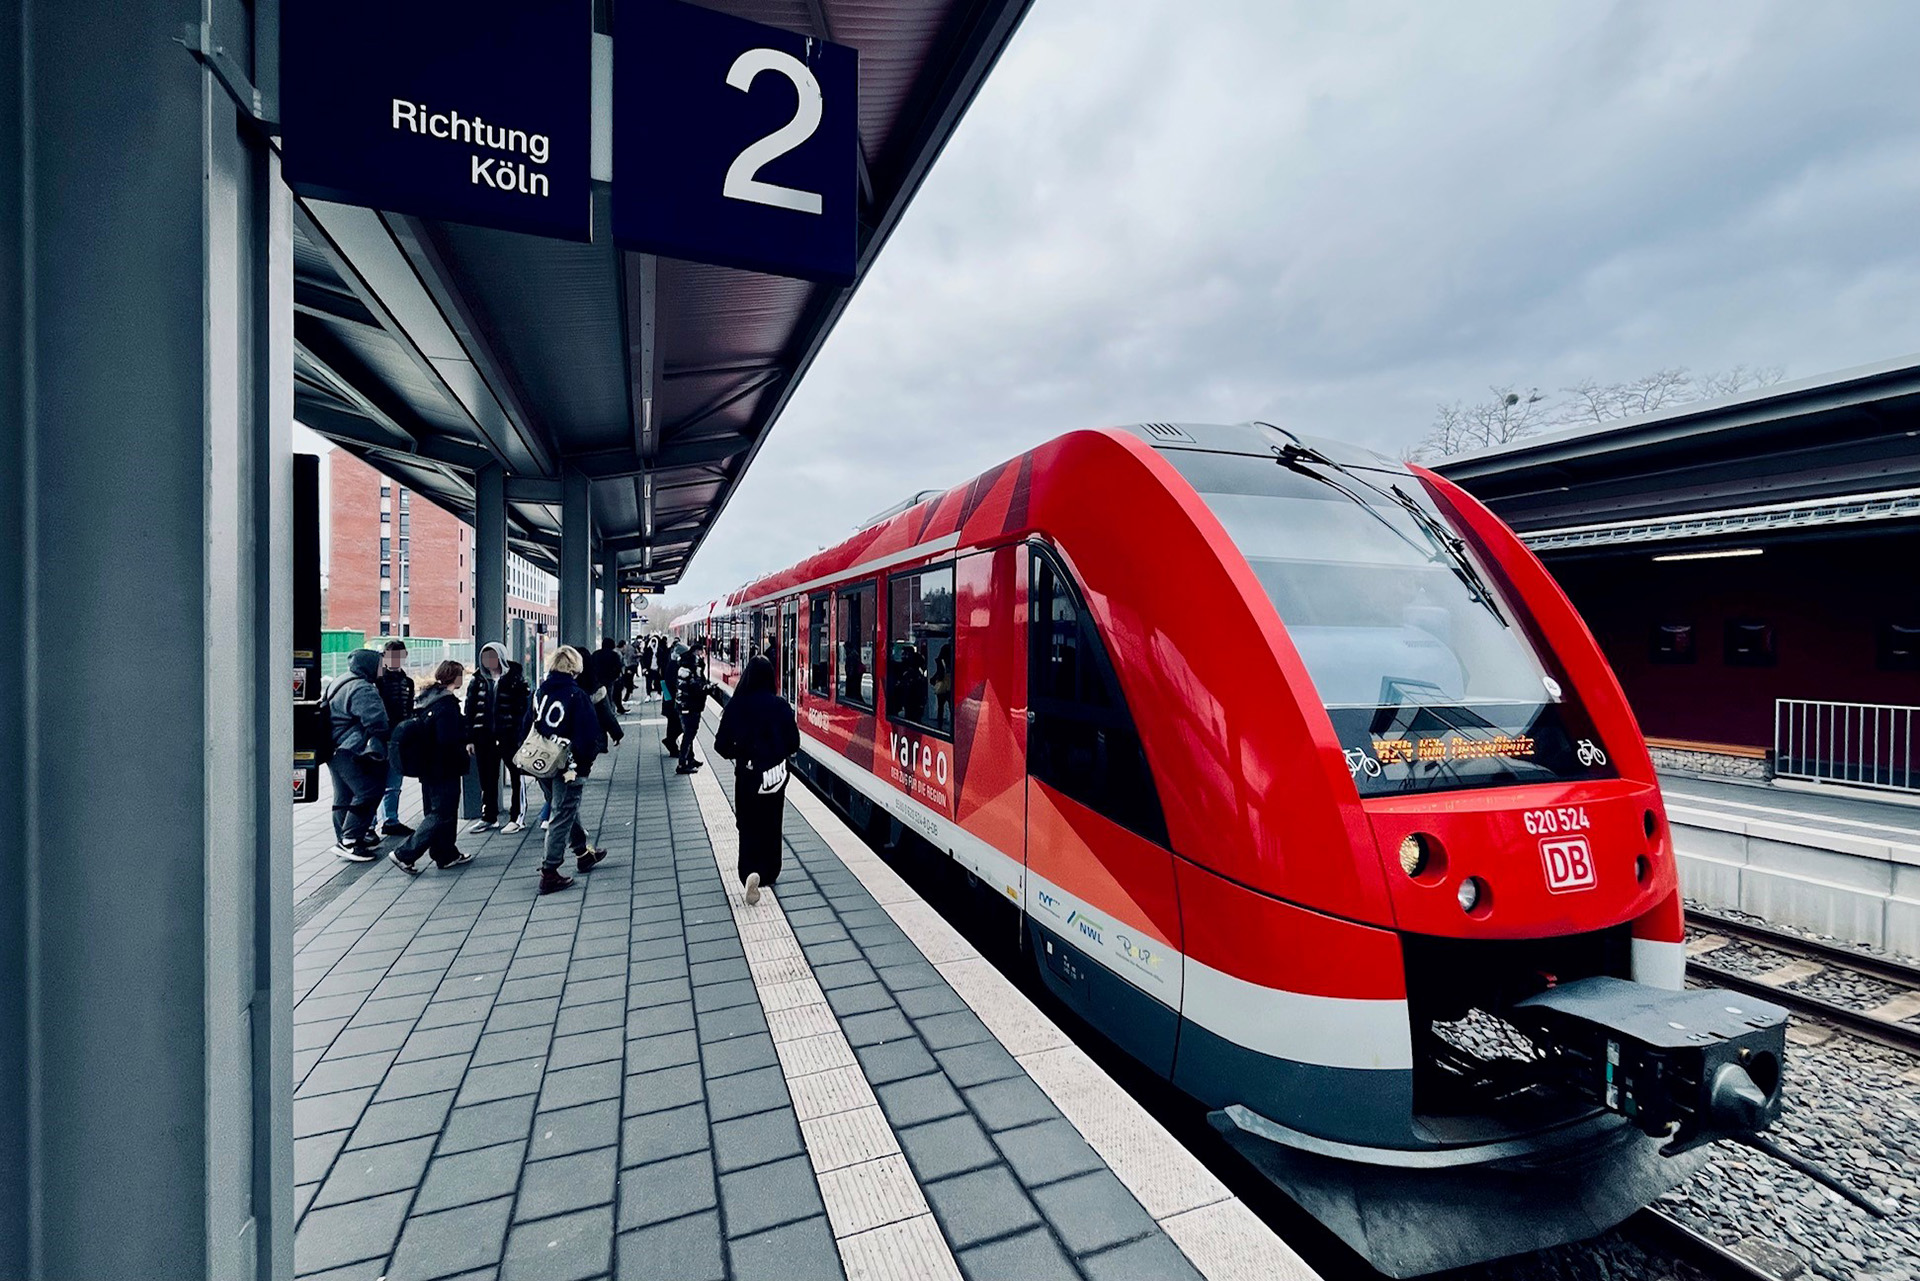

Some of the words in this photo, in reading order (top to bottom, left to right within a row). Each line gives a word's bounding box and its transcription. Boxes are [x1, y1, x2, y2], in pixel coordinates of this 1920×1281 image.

[392, 98, 549, 164] Richtung
[723, 48, 823, 215] 2
[471, 155, 549, 197] Köln
[889, 731, 948, 786] vareo
[890, 766, 899, 779] DER
[899, 770, 908, 785] ZUG
[918, 780, 926, 797] DIE
[926, 784, 947, 807] REGION
[1523, 811, 1558, 834] 620
[1557, 807, 1590, 831] 524
[1547, 845, 1589, 883] DB
[1079, 921, 1104, 946] NWL
